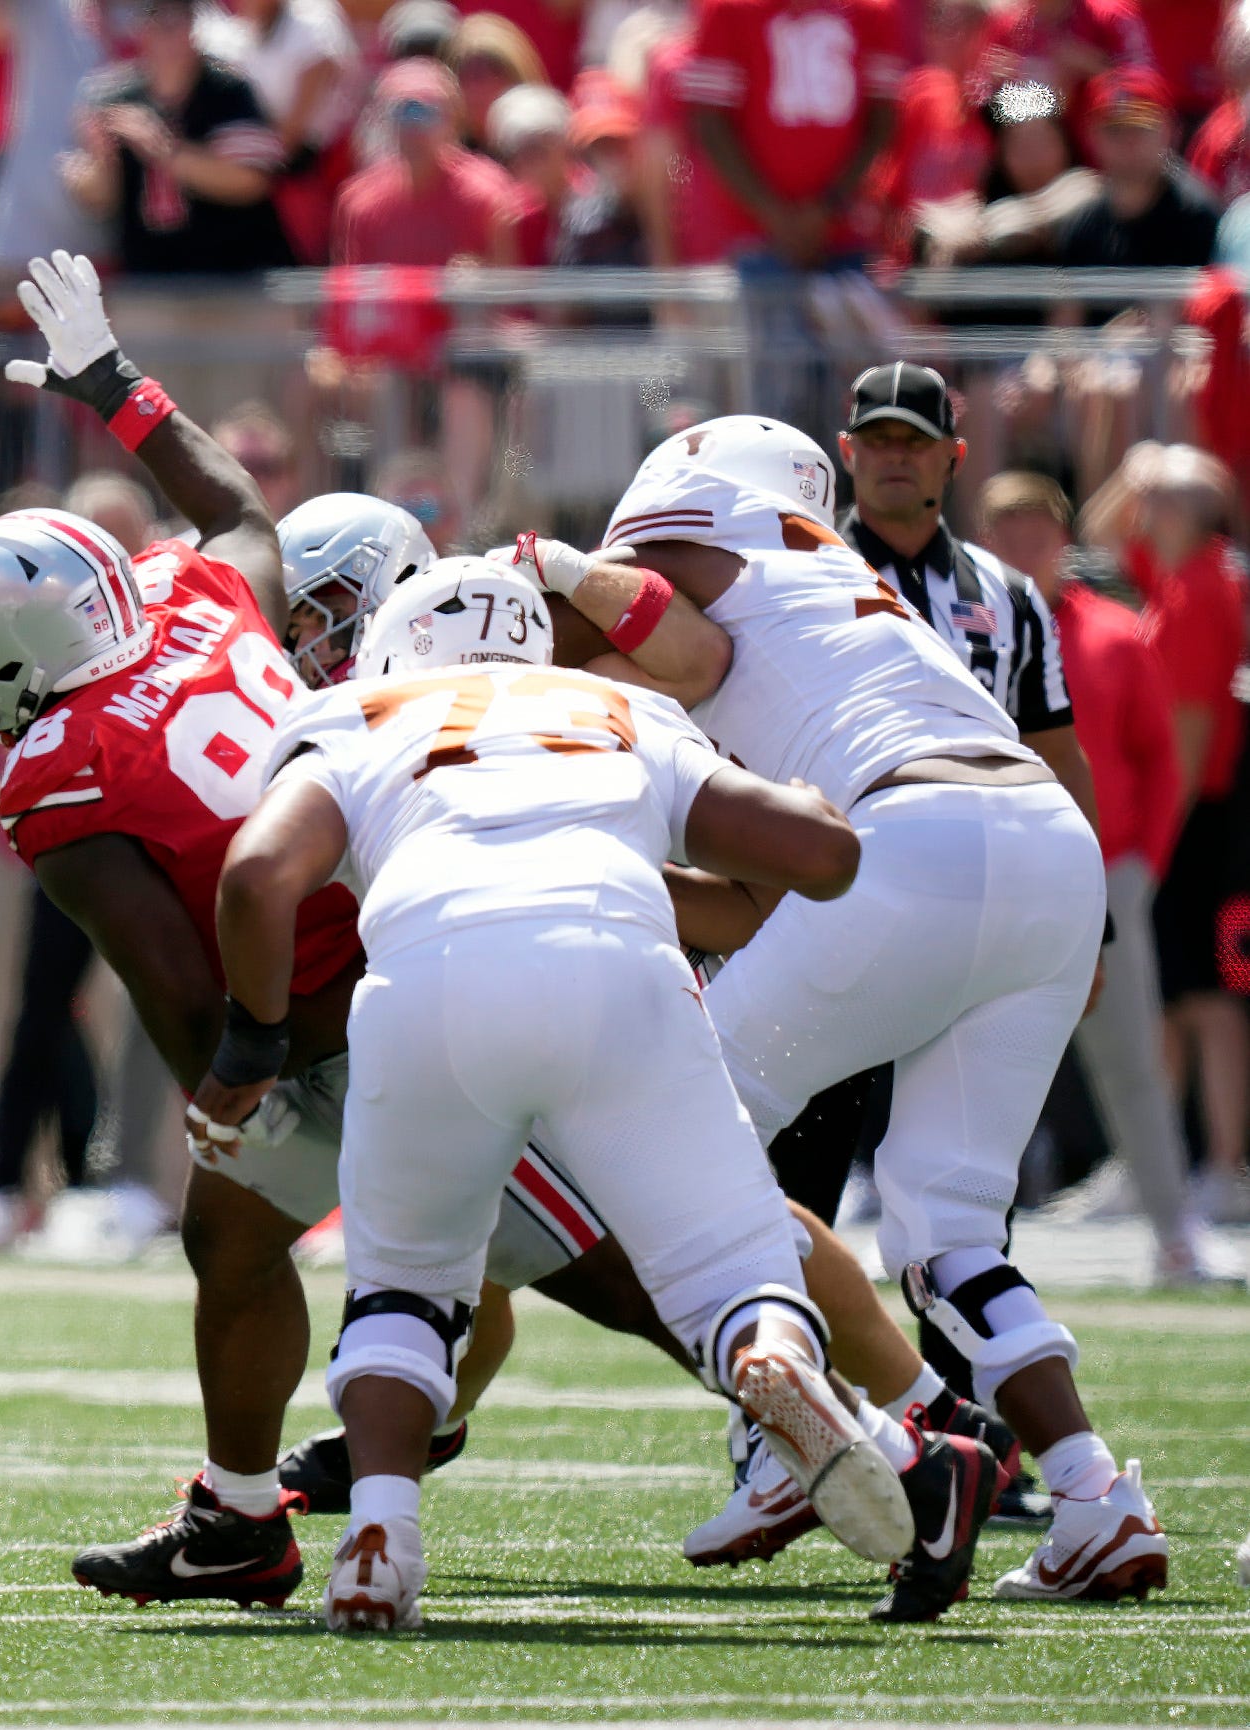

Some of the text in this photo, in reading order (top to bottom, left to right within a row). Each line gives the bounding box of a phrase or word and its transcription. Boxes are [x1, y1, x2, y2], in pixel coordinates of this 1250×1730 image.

[765, 10, 856, 126] 16
[93, 618, 110, 634] 98
[471, 592, 528, 644] 73
[358, 674, 639, 781] 73
